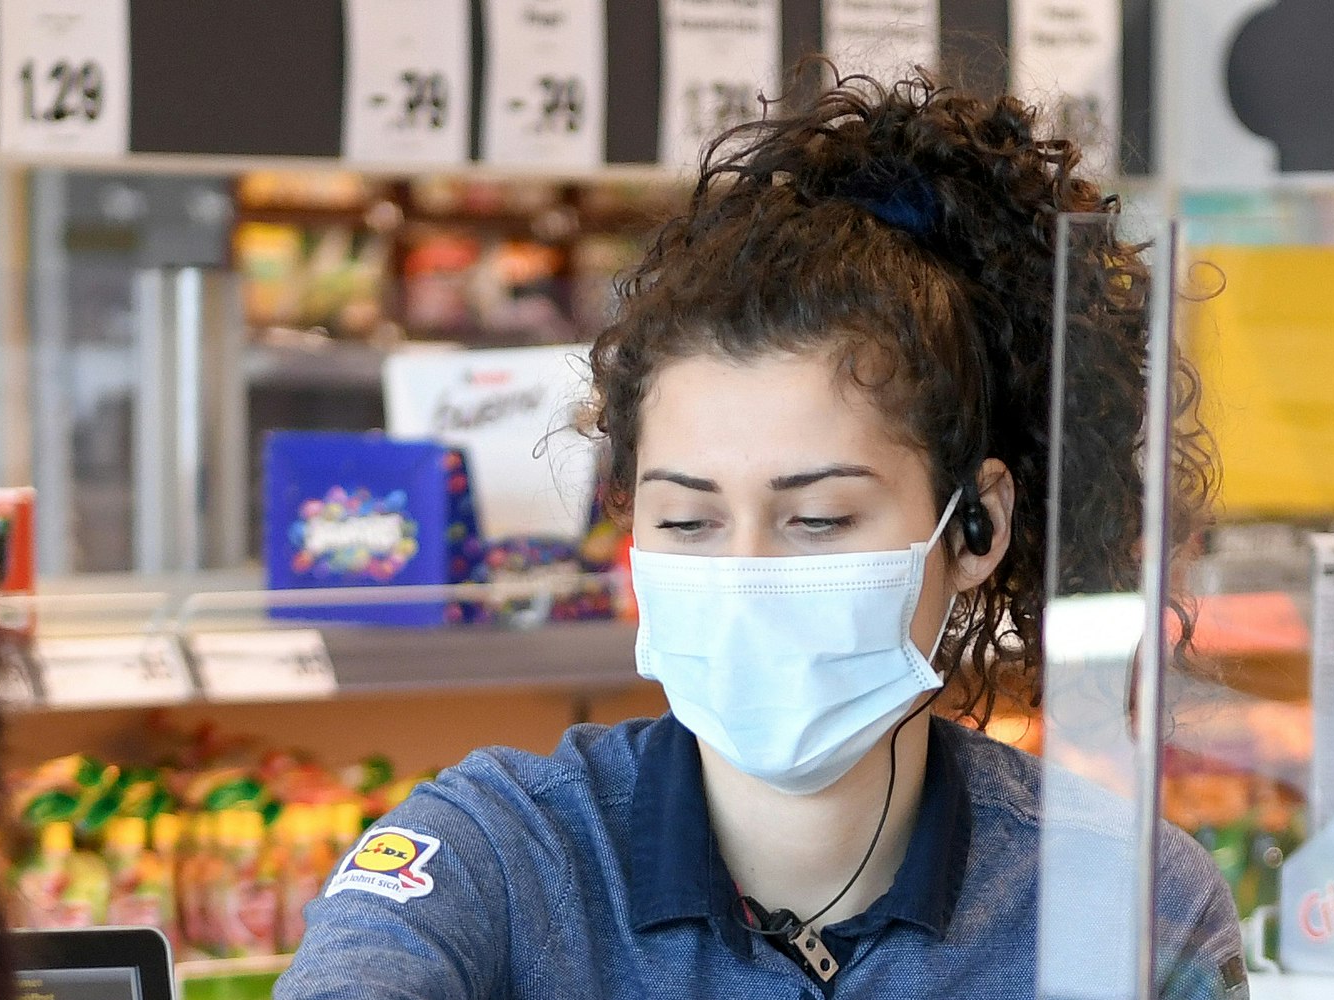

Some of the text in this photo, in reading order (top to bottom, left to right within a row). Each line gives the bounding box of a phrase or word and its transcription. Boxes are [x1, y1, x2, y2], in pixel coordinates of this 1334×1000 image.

[19, 57, 104, 122] 1.29
[349, 874, 376, 885] lohnt
[377, 879, 402, 893] sich.
